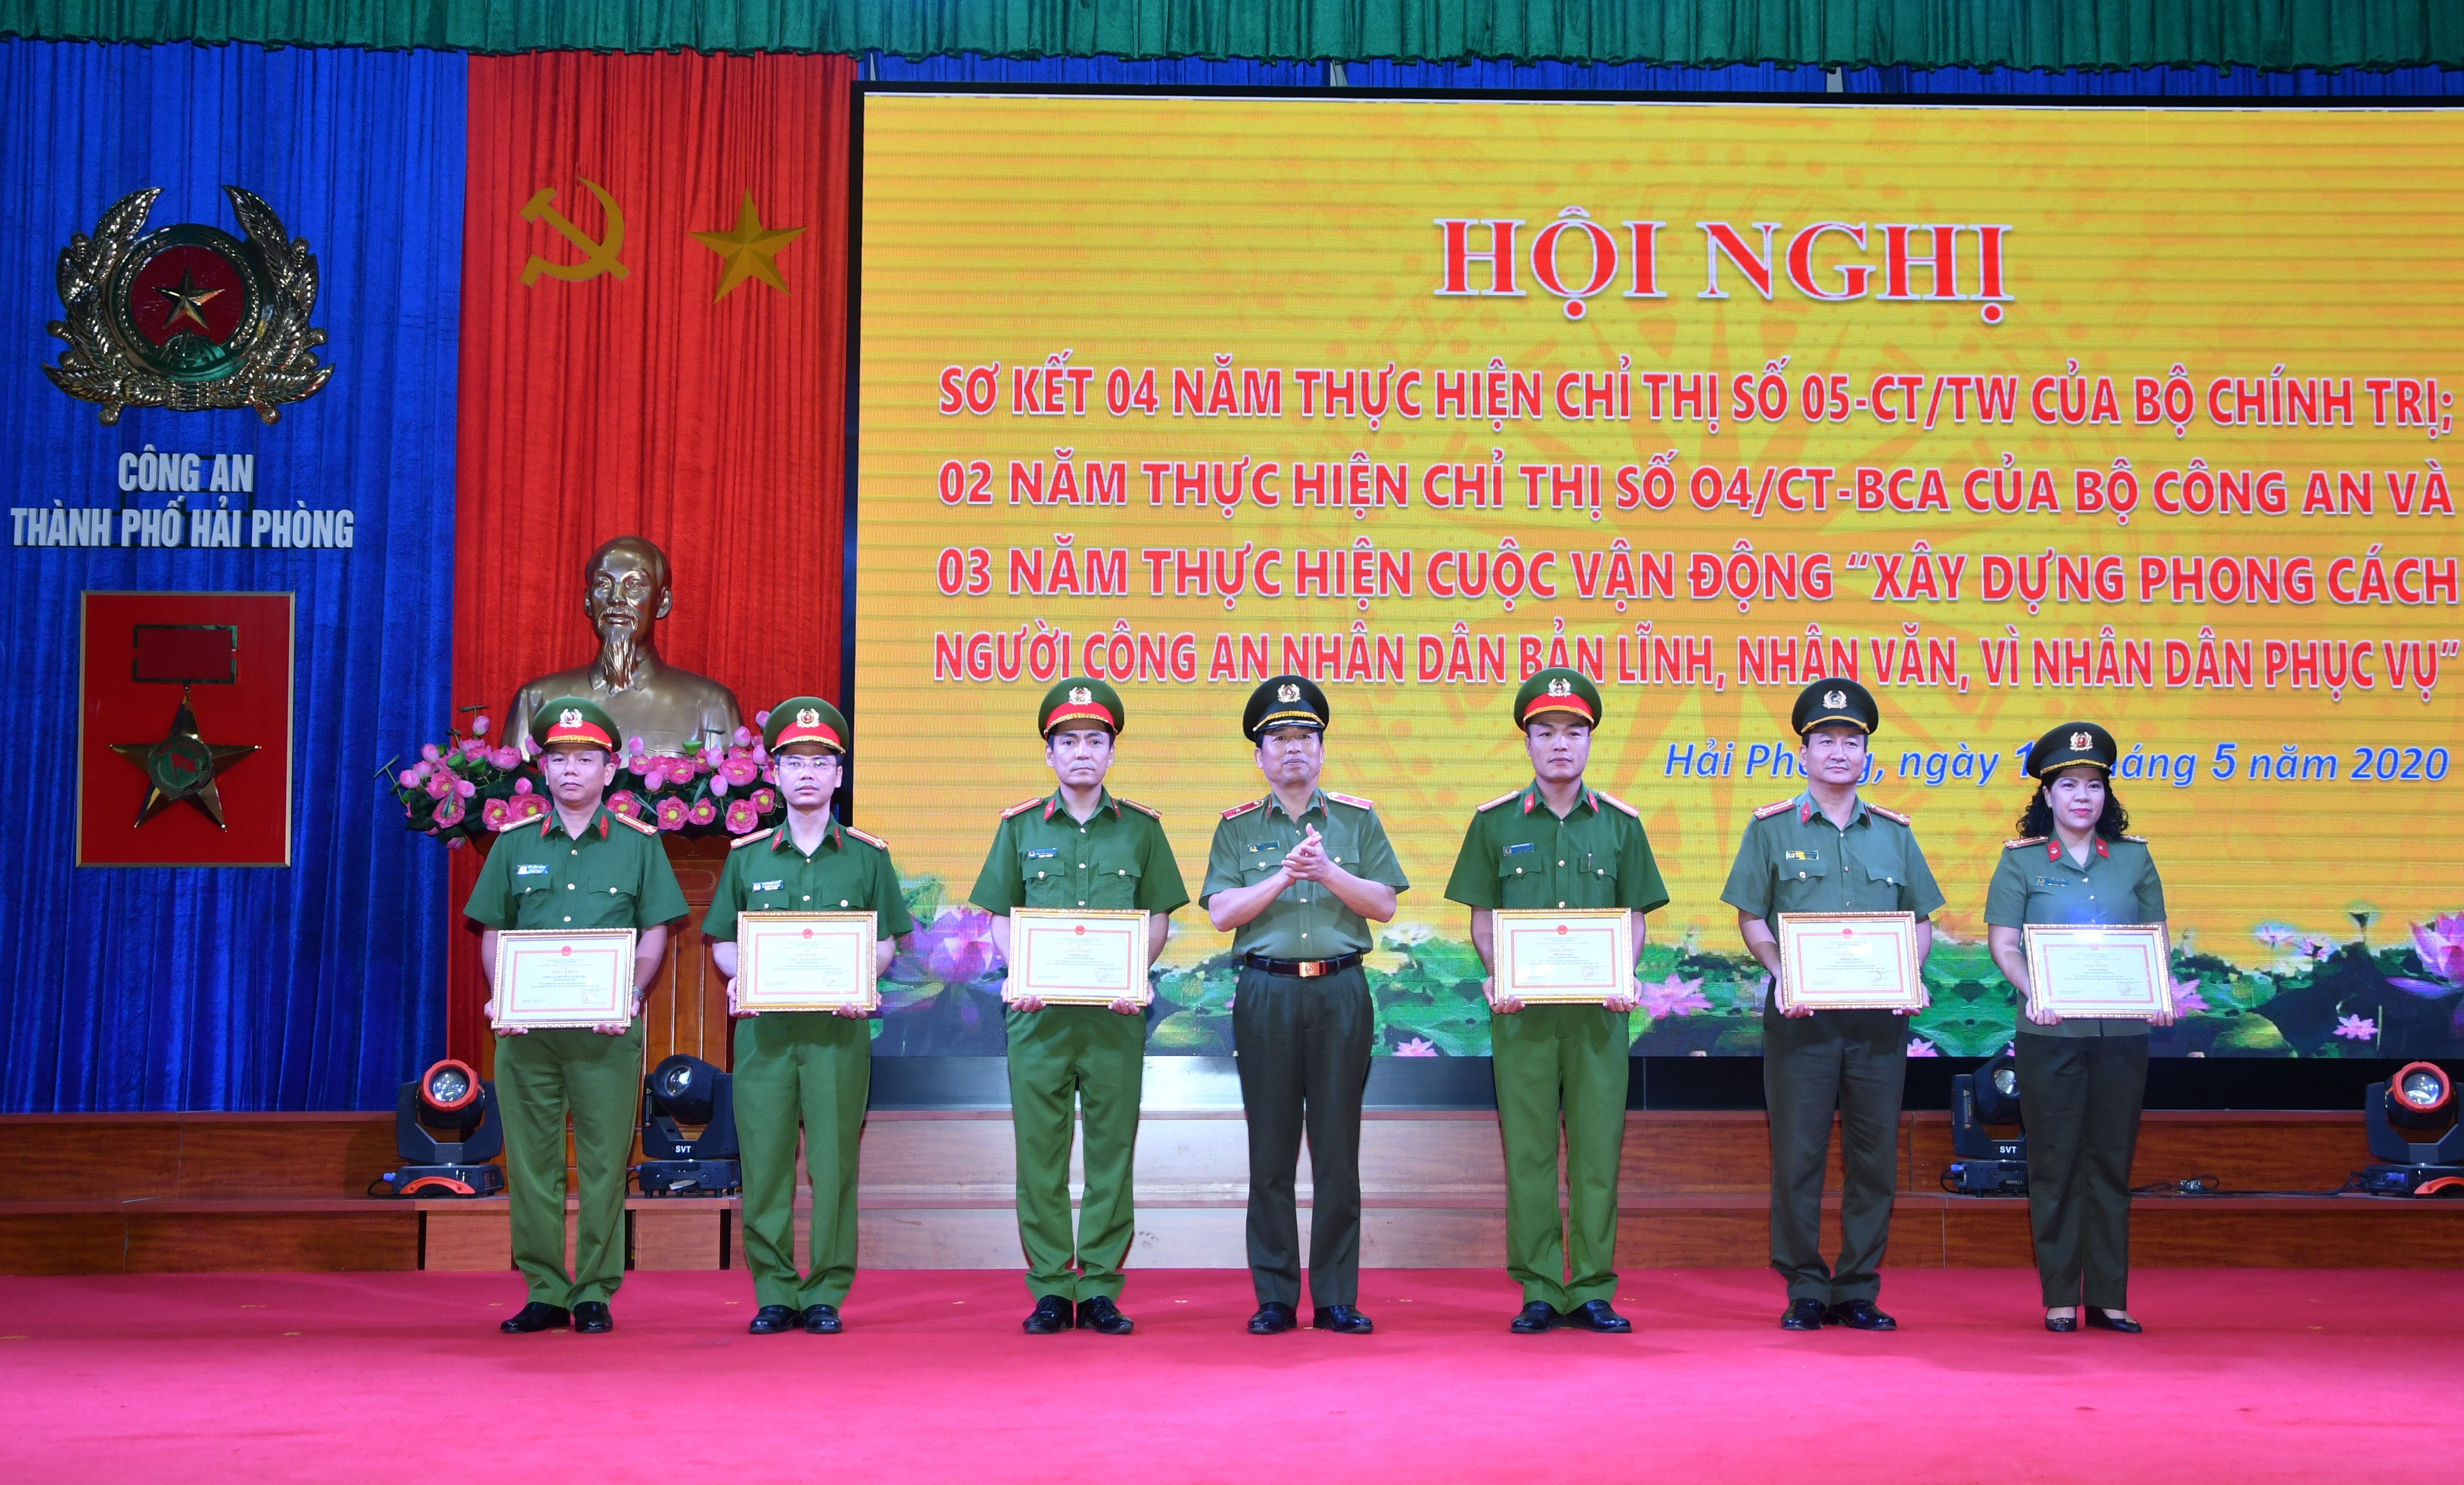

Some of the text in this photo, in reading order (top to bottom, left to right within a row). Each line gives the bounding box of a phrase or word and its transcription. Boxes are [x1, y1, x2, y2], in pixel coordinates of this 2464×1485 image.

[1433, 206, 2014, 324] HỘI NGHỊ
[940, 349, 2452, 438] SƠ KẾT 04 NĂM THỰC HIỆN CHỈ THỊ SỐ 05-CT/TW CỦA BỘ CHÍNH TRỊ;
[118, 444, 254, 492] CÔNG AN
[938, 461, 992, 504] 02
[1010, 448, 1127, 504] NĂM
[1142, 455, 1279, 517] THỰC
[1293, 451, 1408, 518] HIỆN
[1423, 449, 1504, 507] CHỈ
[1519, 465, 1601, 520] THỊ
[1616, 449, 1676, 509] SỐ
[1963, 453, 2059, 511] CỦA
[2075, 458, 2139, 524] BỘ
[2153, 457, 2287, 514] CÔNG
[2302, 472, 2372, 513] AN
[2386, 459, 2453, 514] VÀ
[11, 495, 354, 548] THÀNH PHỐ HẢI PHÒNG
[937, 535, 2458, 613] 03 NĂM THỰC HIỆN CUỘC VẬN ĐỘNG “XÂY DỰNG PHONG CÁCH
[935, 618, 2459, 701] NGƯỜI CÔNG AN NHÂN DÂN BẢN LĨNH, NHÂN VĂN, VÌ NHÂN DÂN PHỤC VỤ”
[1663, 737, 2450, 787] Hải Phg, ngày 1 áng 5 năm 2020
[675, 1145, 692, 1153] SVT
